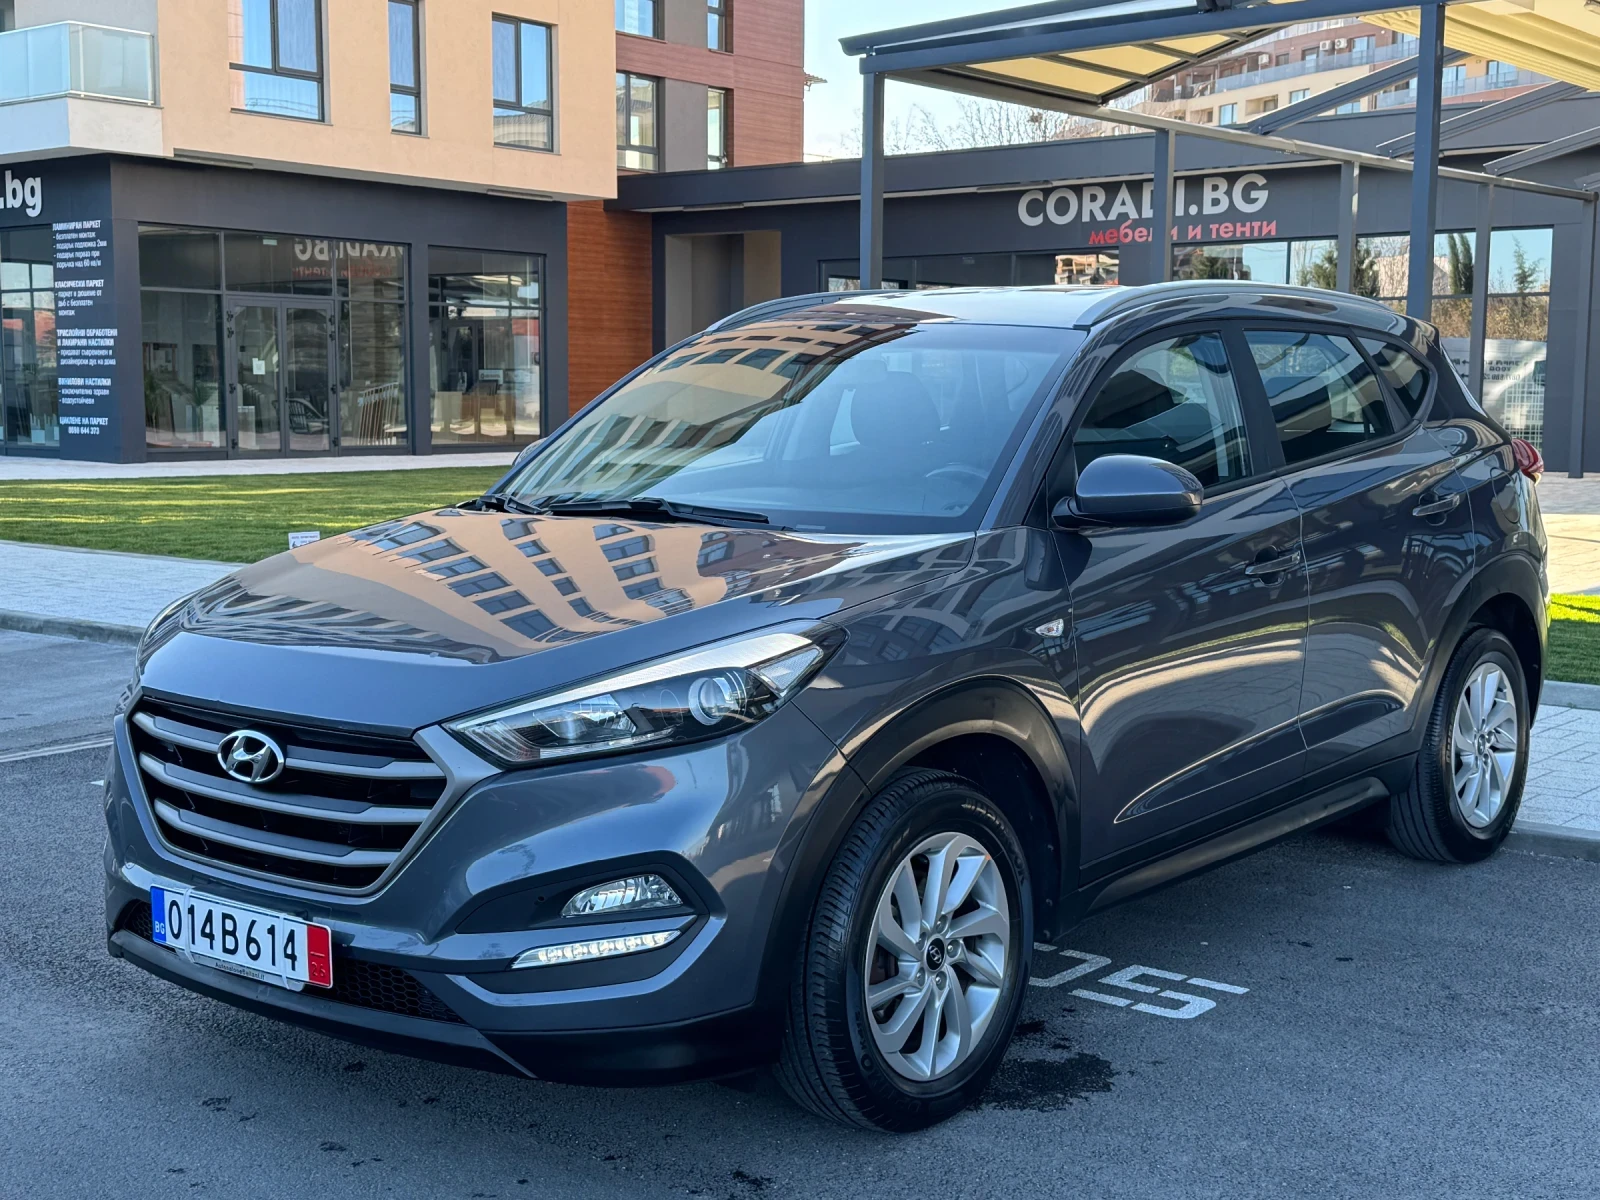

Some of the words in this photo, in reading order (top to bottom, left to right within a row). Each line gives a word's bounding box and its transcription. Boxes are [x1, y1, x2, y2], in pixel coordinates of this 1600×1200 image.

[0, 170, 42, 218] .bg
[83, 220, 101, 228] ПАРКЕТ
[1188, 224, 1202, 240] и
[1210, 220, 1277, 239] тенти
[60, 417, 81, 425] ЦИКЛЕНЕ
[155, 920, 165, 934] BG
[168, 900, 298, 972] 014B614
